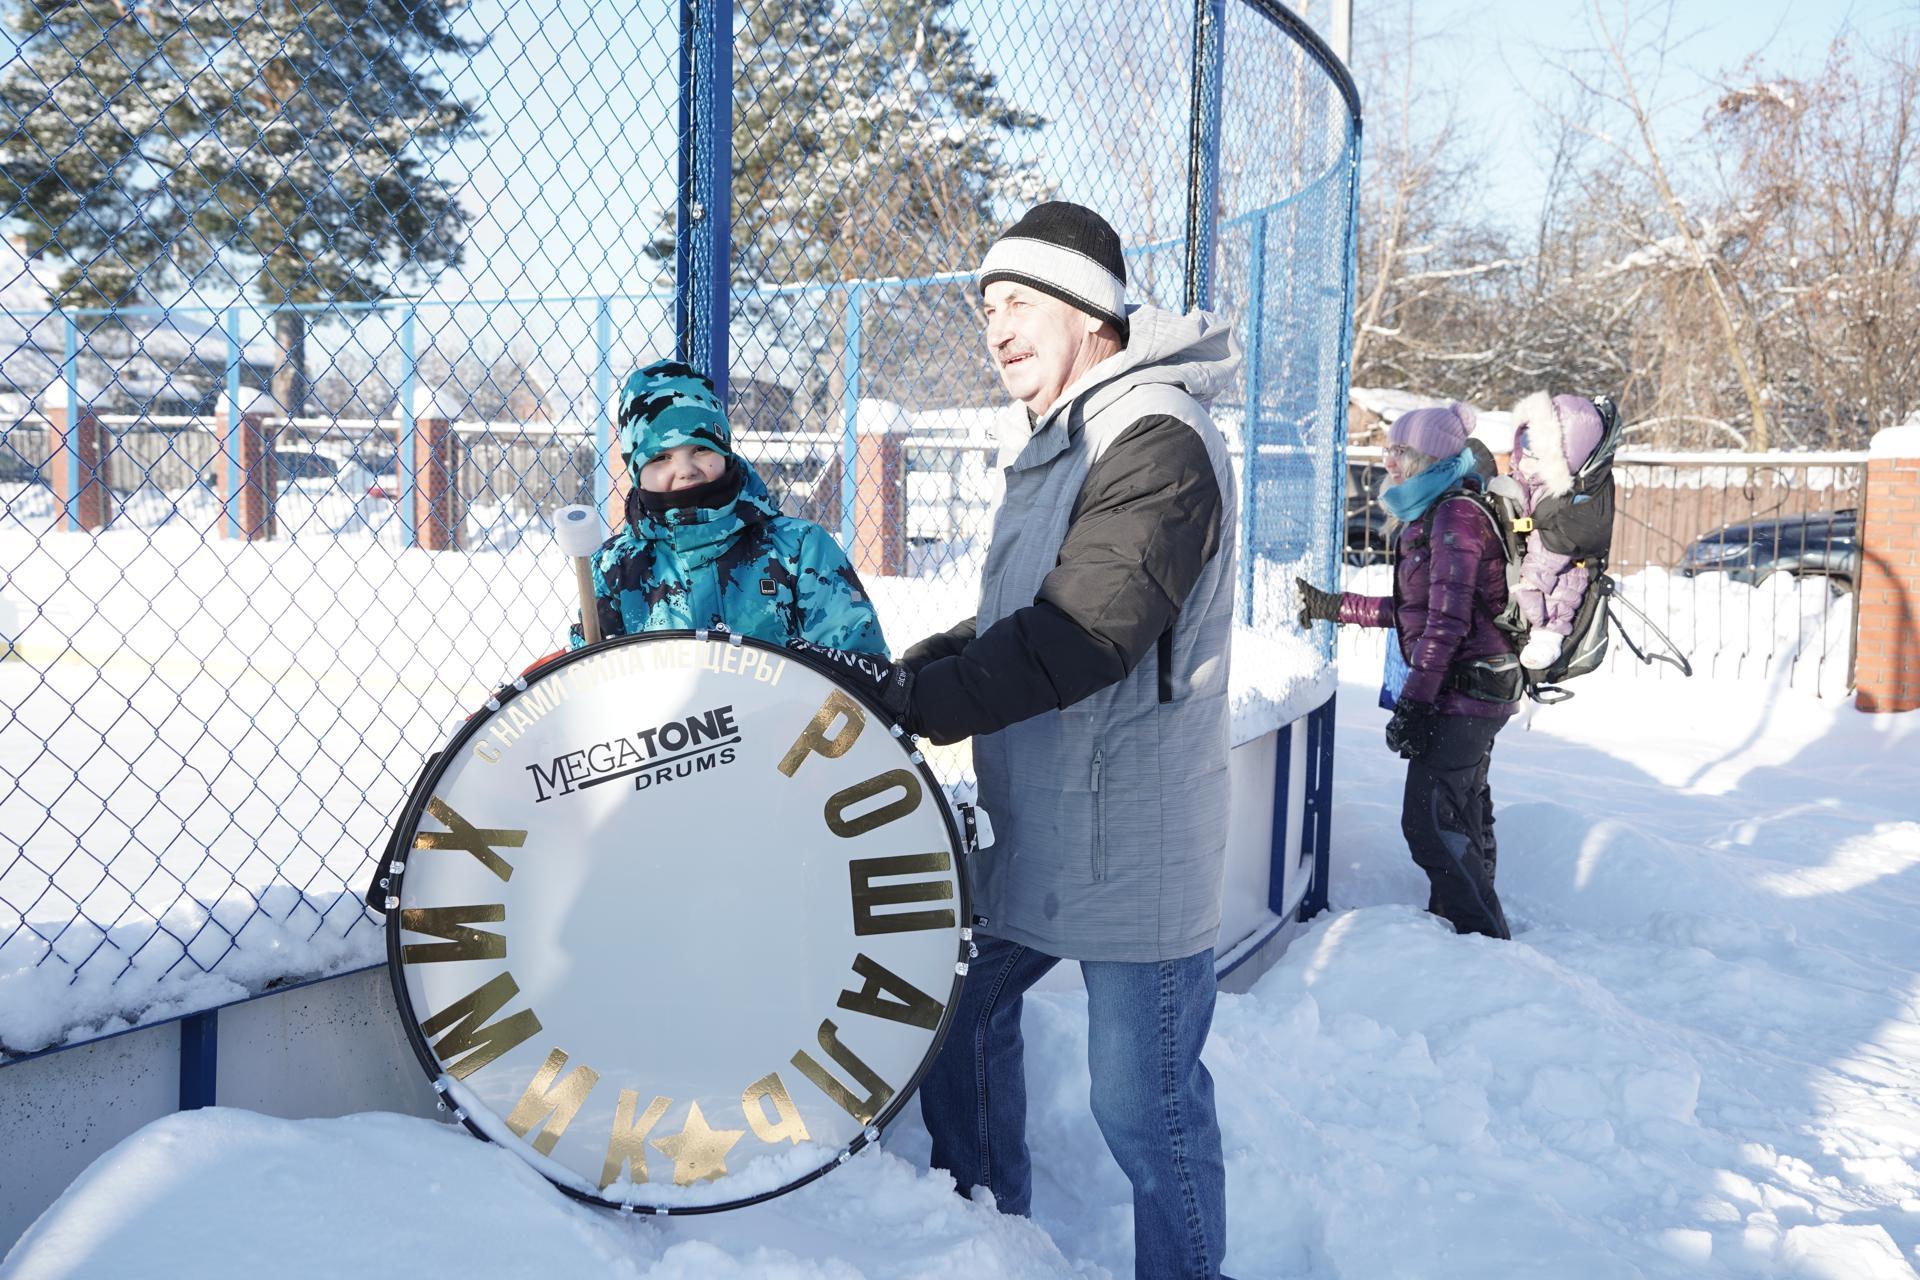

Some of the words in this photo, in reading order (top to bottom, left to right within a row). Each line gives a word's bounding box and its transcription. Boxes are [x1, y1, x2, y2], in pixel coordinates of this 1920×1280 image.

[473, 739, 499, 766] С
[489, 674, 570, 748] НАМИ
[651, 639, 787, 687] МЕЩЕРЫ
[525, 704, 740, 803] MEGATONE
[634, 748, 737, 791] DRUMS
